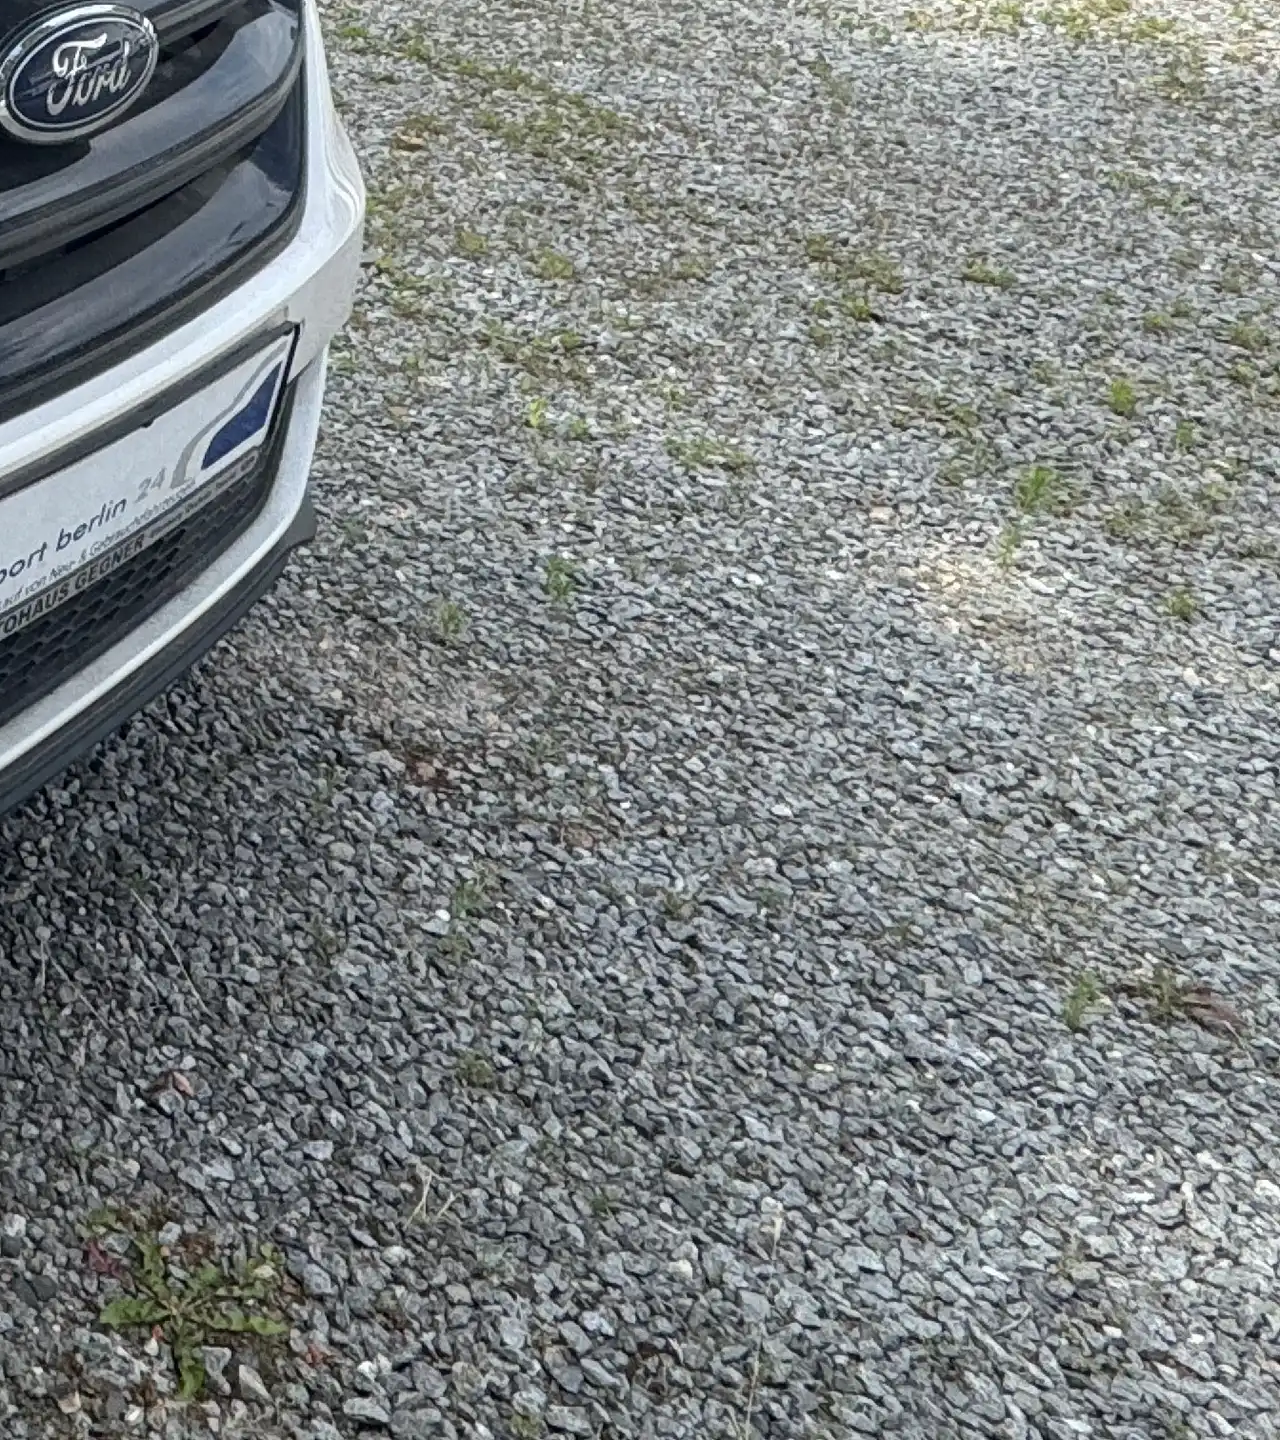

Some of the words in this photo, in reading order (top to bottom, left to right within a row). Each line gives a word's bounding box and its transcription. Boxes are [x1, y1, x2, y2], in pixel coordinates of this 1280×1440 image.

[46, 32, 132, 116] Ford
[55, 498, 128, 552] berlin
[135, 467, 167, 503] 24
[74, 533, 146, 590] GEGNER
